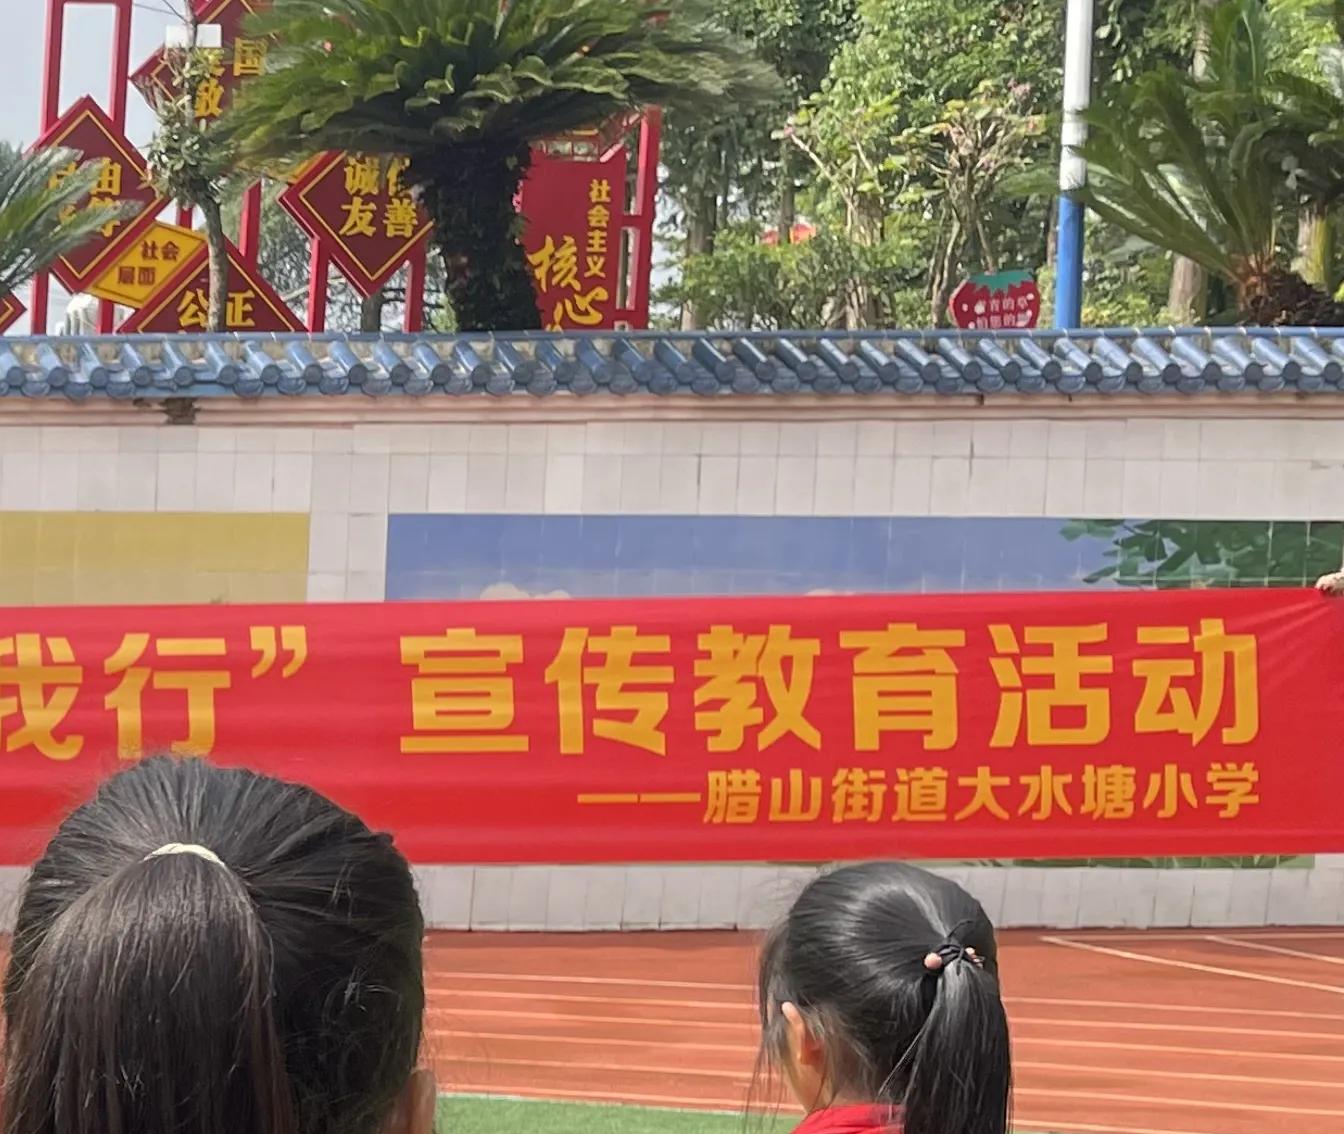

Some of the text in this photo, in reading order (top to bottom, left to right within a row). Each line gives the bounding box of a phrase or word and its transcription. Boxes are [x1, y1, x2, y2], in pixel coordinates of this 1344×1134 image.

[338, 197, 418, 238] 友善
[584, 179, 611, 278] 社会主义
[141, 240, 180, 262] 社会
[526, 234, 609, 325] 核心
